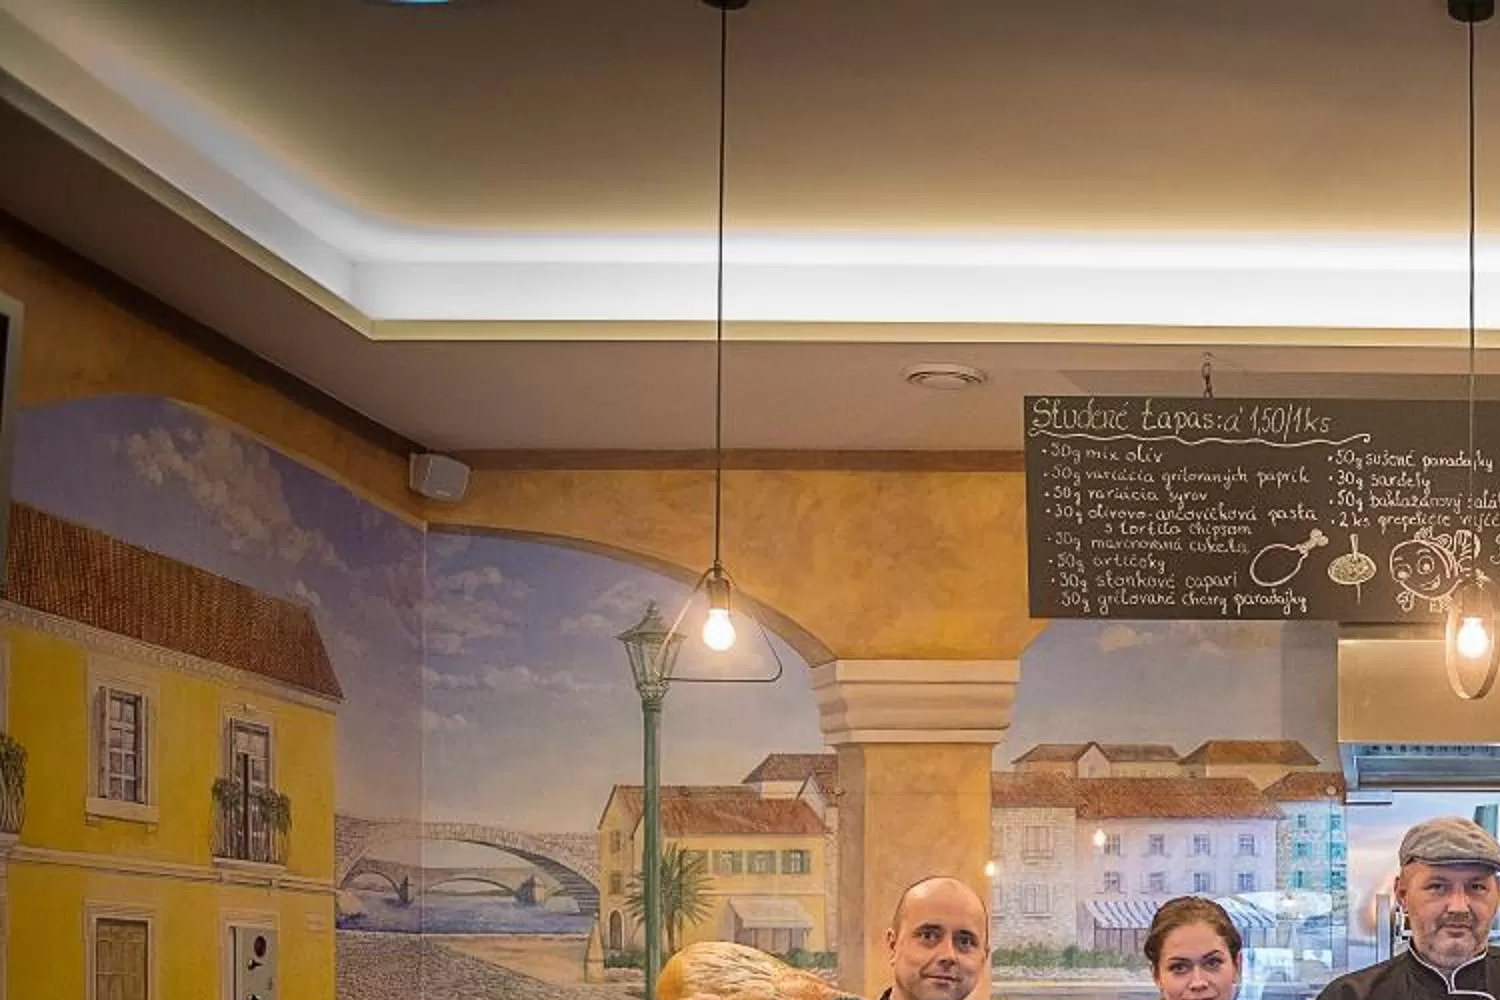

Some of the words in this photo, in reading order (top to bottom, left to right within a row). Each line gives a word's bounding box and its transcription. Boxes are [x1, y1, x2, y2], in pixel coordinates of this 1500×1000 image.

[1032, 397, 1130, 431] Studené
[1085, 446, 1119, 461] mix
[1161, 466, 1249, 491] grilovaných
[1267, 504, 1318, 527] pasta
[1339, 512, 1349, 527] 2
[1352, 512, 1371, 527] ks
[1181, 589, 1227, 615] cherry
